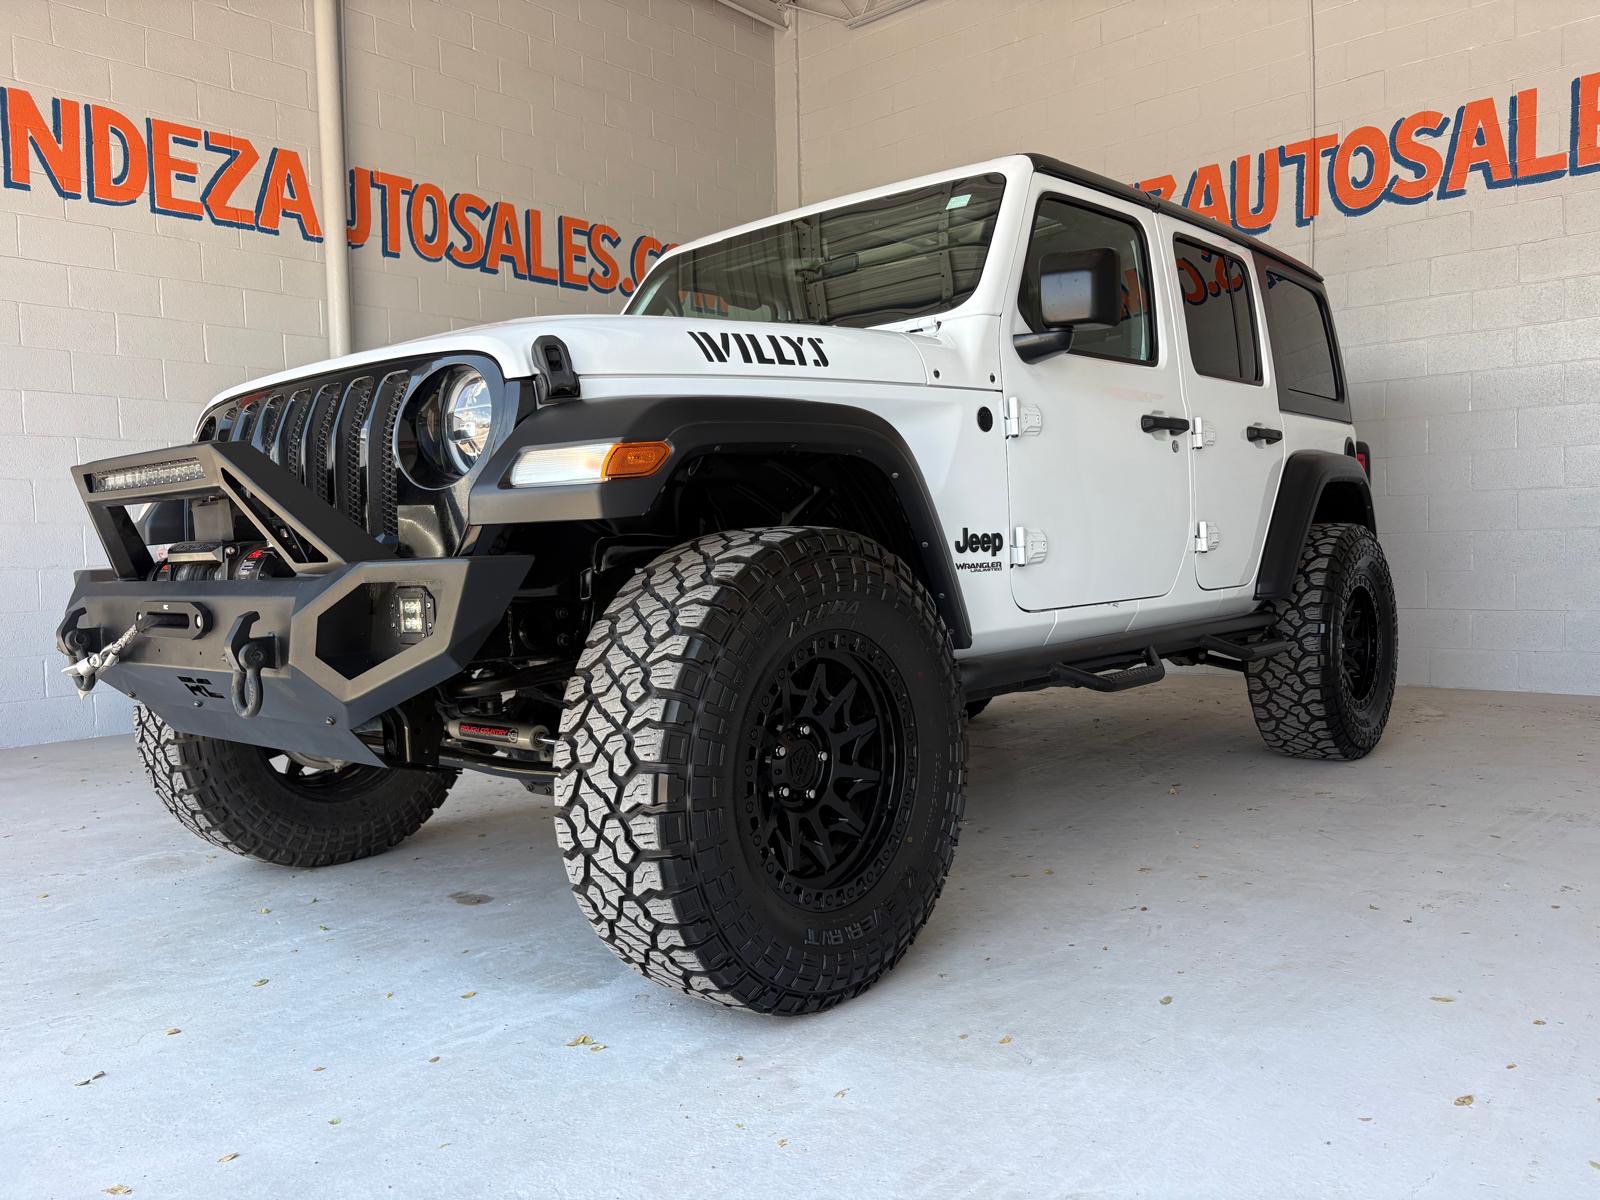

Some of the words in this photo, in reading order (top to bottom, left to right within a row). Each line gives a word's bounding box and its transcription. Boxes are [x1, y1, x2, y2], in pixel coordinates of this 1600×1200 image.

[687, 330, 830, 368] WILLYS
[954, 527, 1004, 557] Jeep
[955, 561, 1002, 570] WRANGLER
